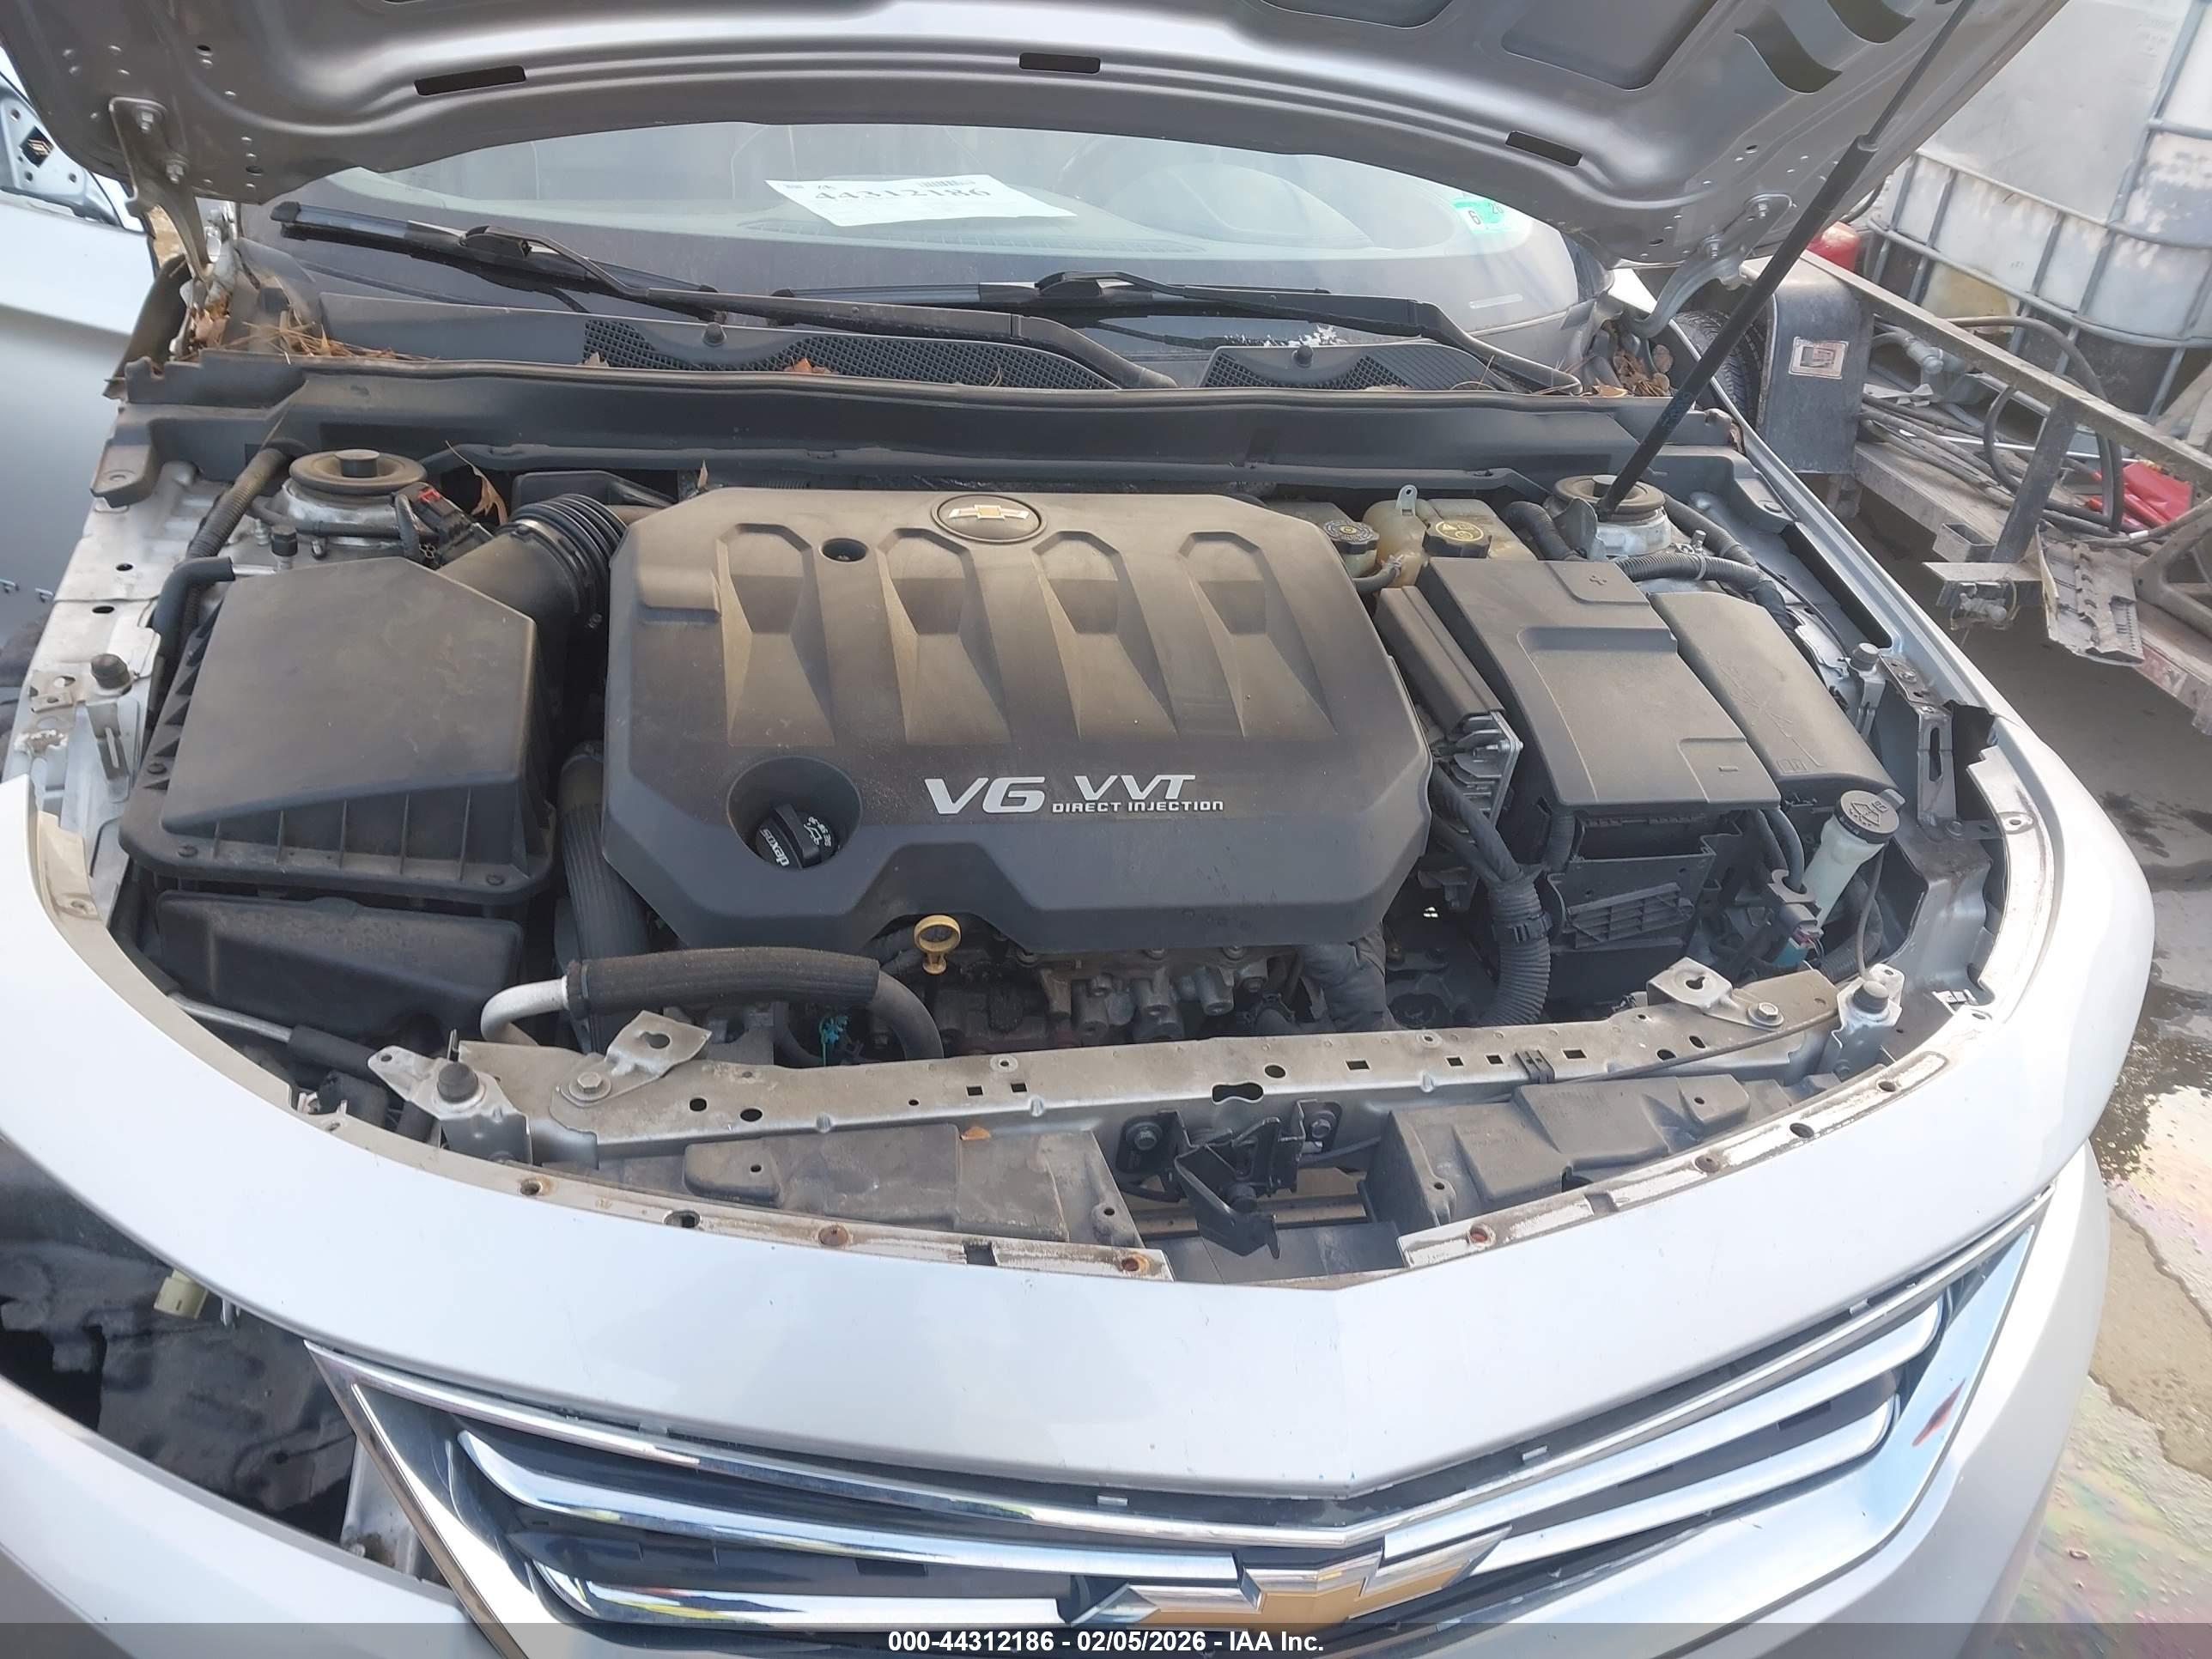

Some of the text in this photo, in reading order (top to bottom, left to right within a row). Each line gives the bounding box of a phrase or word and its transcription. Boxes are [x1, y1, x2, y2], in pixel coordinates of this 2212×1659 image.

[924, 775, 1196, 815] V6 VVT
[1052, 800, 1224, 813] DIRECT INJECTION
[759, 828, 790, 866] dexos
